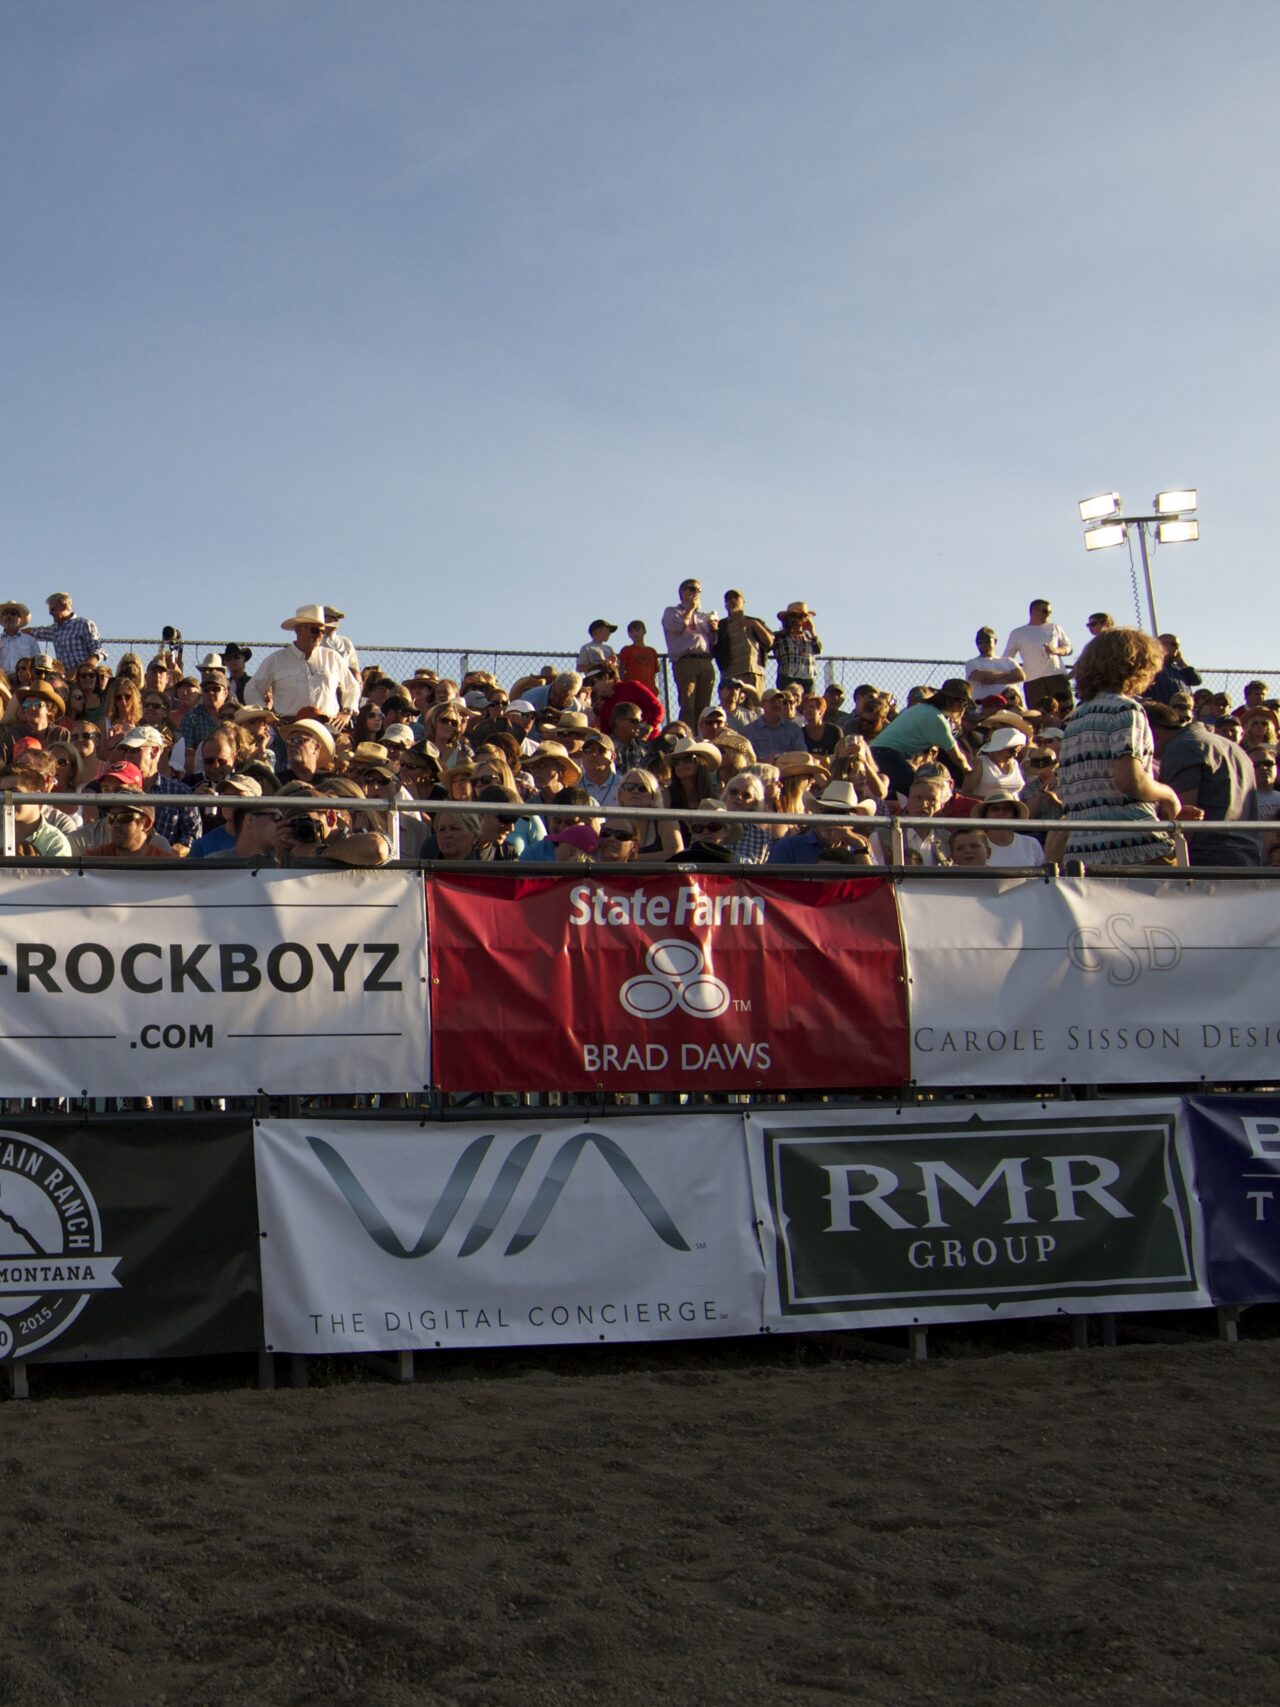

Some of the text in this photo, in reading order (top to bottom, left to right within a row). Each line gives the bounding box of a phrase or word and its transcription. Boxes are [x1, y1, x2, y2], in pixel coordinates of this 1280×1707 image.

[130, 1024, 214, 1049] .COM
[914, 1024, 1280, 1052] CAROLE SISSON DESI
[583, 1042, 771, 1071] BRAD DAWS
[820, 1155, 1136, 1232] RMR
[43, 1168, 90, 1248] RANCH
[908, 1235, 1056, 1269] GROUP
[19, 1307, 53, 1335] 2015
[309, 1313, 365, 1334] THE
[385, 1308, 510, 1332] DIGITAL
